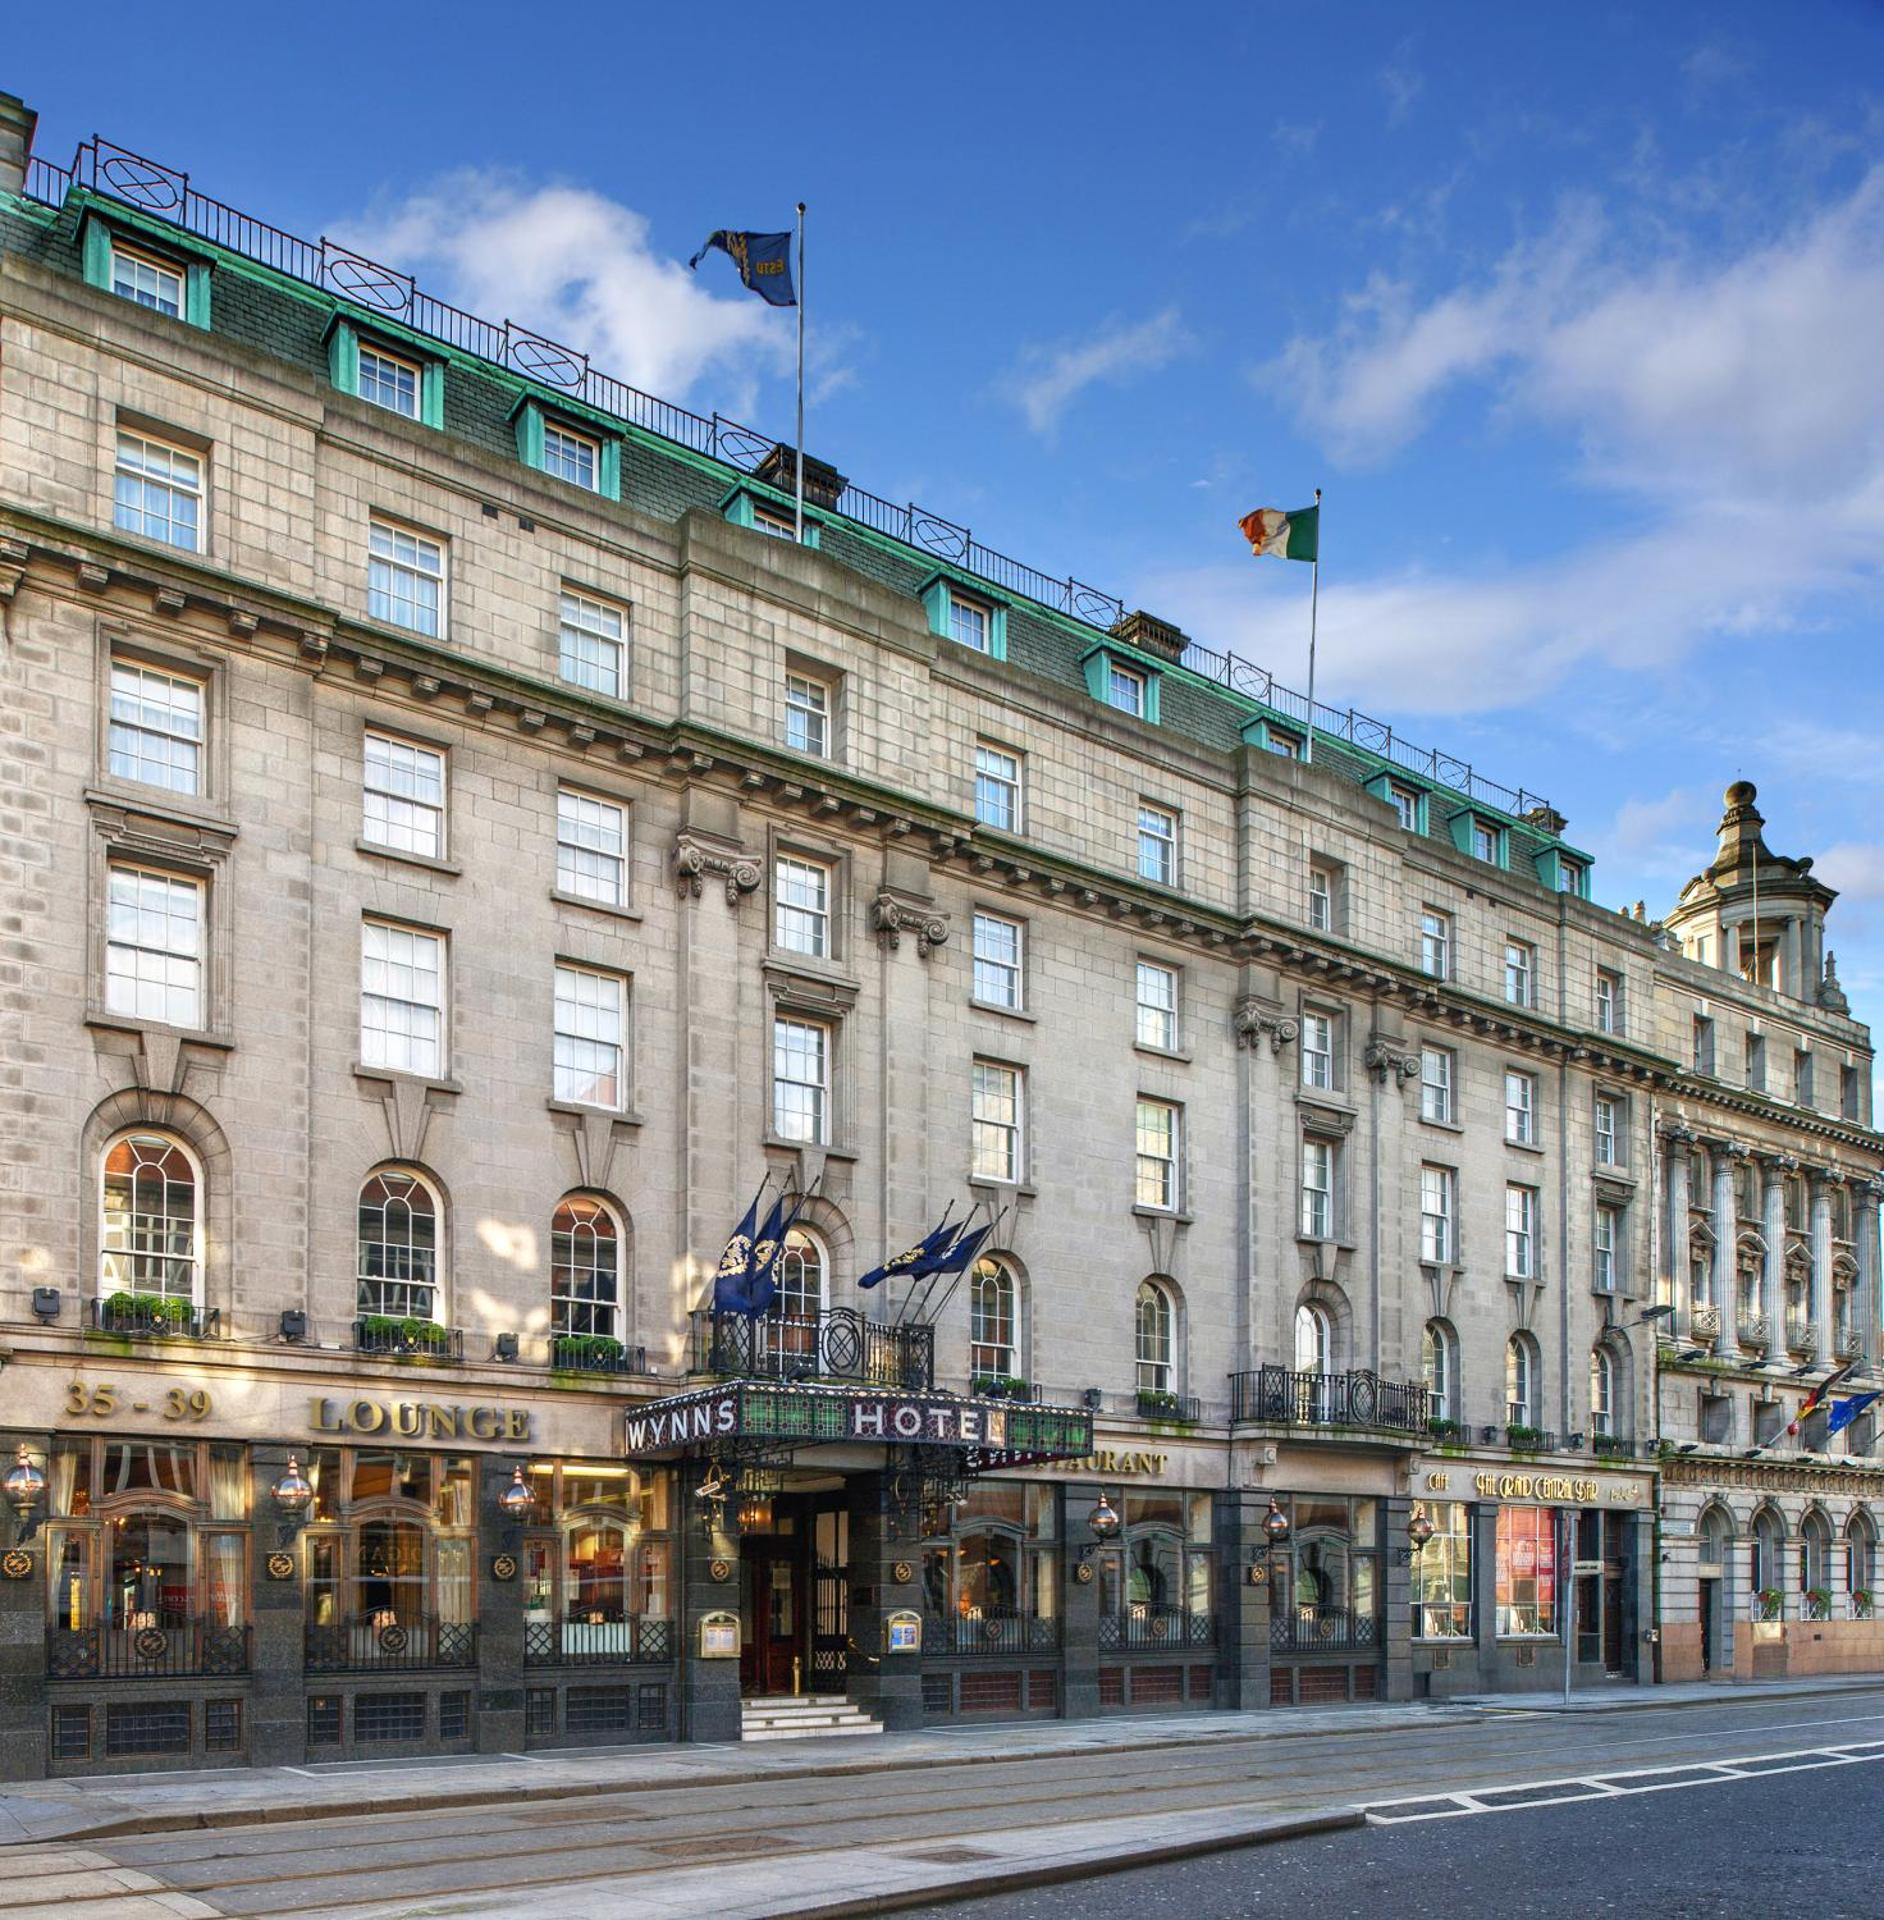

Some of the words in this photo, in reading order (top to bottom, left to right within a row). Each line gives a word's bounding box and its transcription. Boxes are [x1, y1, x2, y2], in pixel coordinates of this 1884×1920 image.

[65, 1381, 117, 1416] 35
[163, 1387, 213, 1422] 39
[307, 1396, 531, 1441] LOUNGE
[628, 1399, 735, 1451] WYNNS
[854, 1403, 1004, 1443] HOTEL
[1476, 1472, 1497, 1497] THE
[1499, 1474, 1533, 1499] GRAND
[1535, 1476, 1575, 1500] CENTRAL
[1575, 1478, 1599, 1502] BAR
